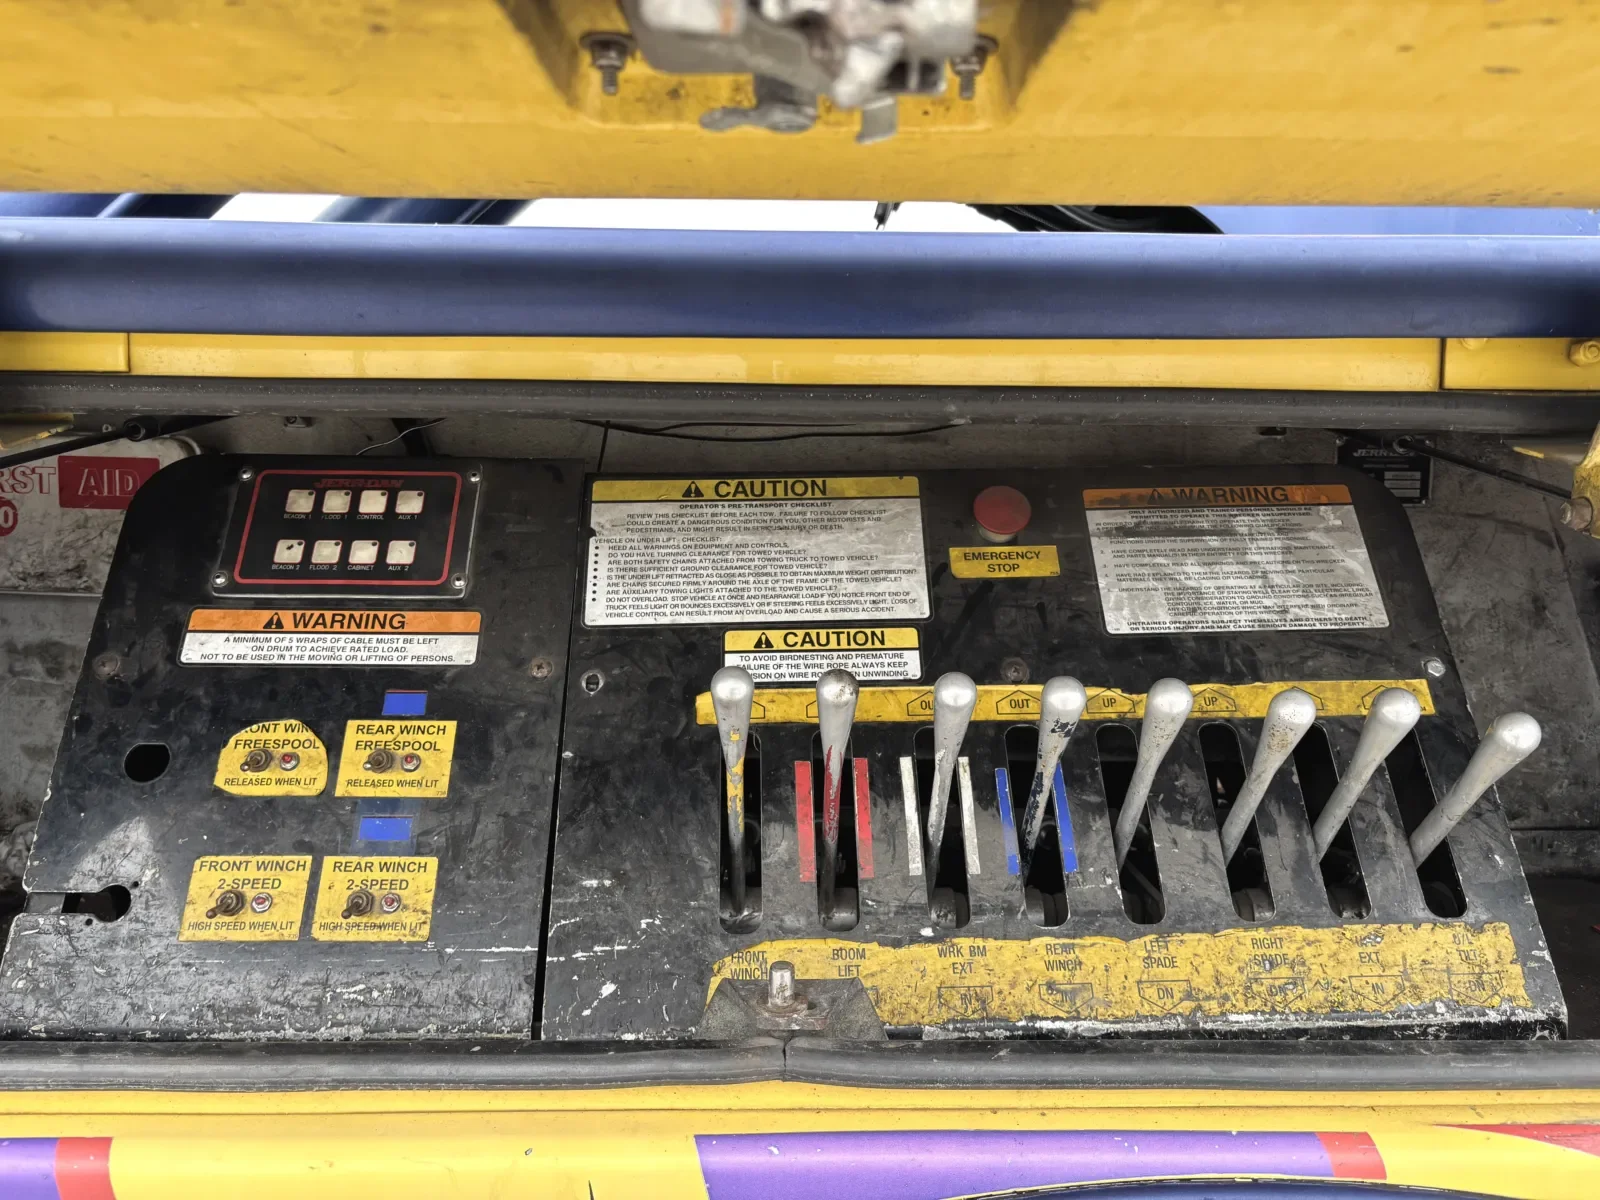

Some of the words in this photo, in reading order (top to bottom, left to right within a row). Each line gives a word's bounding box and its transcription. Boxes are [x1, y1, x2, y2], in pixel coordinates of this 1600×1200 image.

[0, 466, 56, 494] RST
[77, 467, 140, 497] AID
[714, 479, 827, 498] CAUTION
[1171, 486, 1289, 503] WARNING
[963, 551, 1041, 561] EMERGENCY
[987, 563, 1020, 573] STOP
[292, 612, 407, 630] WARNING
[783, 630, 885, 648] CAUTION
[773, 671, 787, 679] ON
[788, 671, 809, 679] WIRE
[862, 670, 909, 678] UNWINDING
[1009, 698, 1031, 710] OUT
[1102, 697, 1117, 709] UP
[1204, 695, 1218, 707] UP
[356, 724, 395, 735] REAR
[400, 724, 447, 736] WINCH
[234, 738, 320, 750] FREESPOOL
[355, 740, 441, 752] FREESPOOL
[224, 777, 273, 787] RELEASED
[274, 777, 302, 786] WHEN
[303, 777, 318, 786] LIT
[346, 779, 394, 788] RELEASED
[396, 779, 424, 788] WHEN
[425, 779, 439, 788] LIT
[199, 860, 252, 872] FRONT
[255, 860, 307, 872] WINCH
[333, 861, 373, 873] REAR
[378, 861, 428, 873] WINCH
[217, 878, 282, 890] 2-SPEED
[346, 878, 409, 891] 2-SPEED
[188, 921, 212, 931] HIGH
[214, 921, 247, 931] SPEED
[248, 921, 278, 931] WHEN
[279, 921, 295, 931] LIT
[319, 921, 343, 931] HIGH
[344, 921, 376, 931] SPEED
[377, 921, 407, 931] WHEN
[409, 922, 424, 932] LIT
[1045, 943, 1076, 956] REAR
[1143, 940, 1170, 952] LEFT
[1251, 937, 1283, 950] RIGHT
[731, 950, 767, 963] FRONT
[832, 948, 866, 961] BOOM
[937, 946, 965, 958] WRK
[968, 945, 987, 957] BM
[1358, 951, 1380, 964] EXT
[1044, 959, 1082, 972] WINCH
[1142, 957, 1178, 970] SPADE
[1253, 953, 1289, 966] SPADE
[730, 967, 768, 980] WINCH
[838, 965, 861, 977] LIFT
[952, 962, 974, 974] EXT
[1157, 987, 1175, 1000] DN
[1371, 982, 1384, 995] IN
